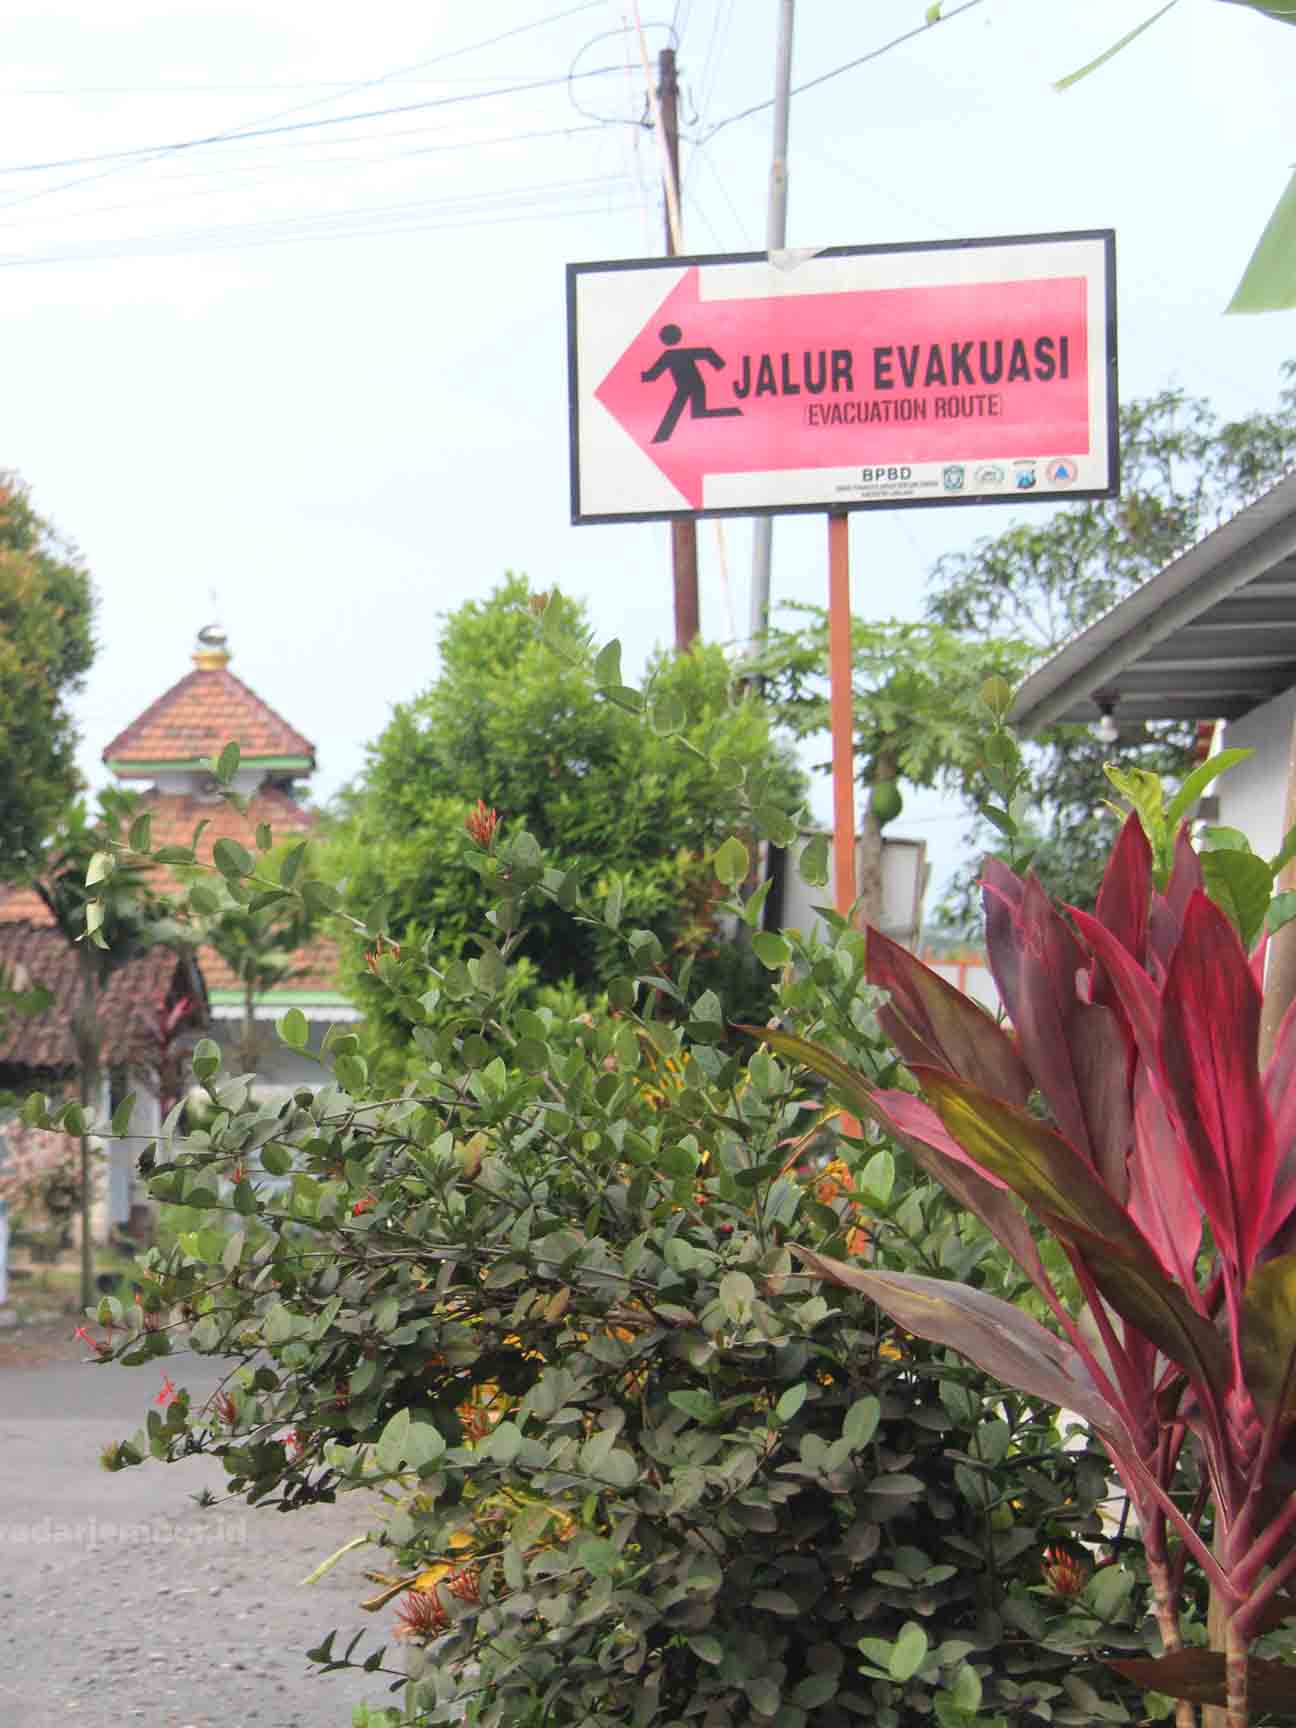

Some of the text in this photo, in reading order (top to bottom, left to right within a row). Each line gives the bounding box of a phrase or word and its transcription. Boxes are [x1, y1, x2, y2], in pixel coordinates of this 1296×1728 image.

[733, 335, 1069, 399] JALUR EVAKUASI
[862, 467, 912, 480] BPBD
